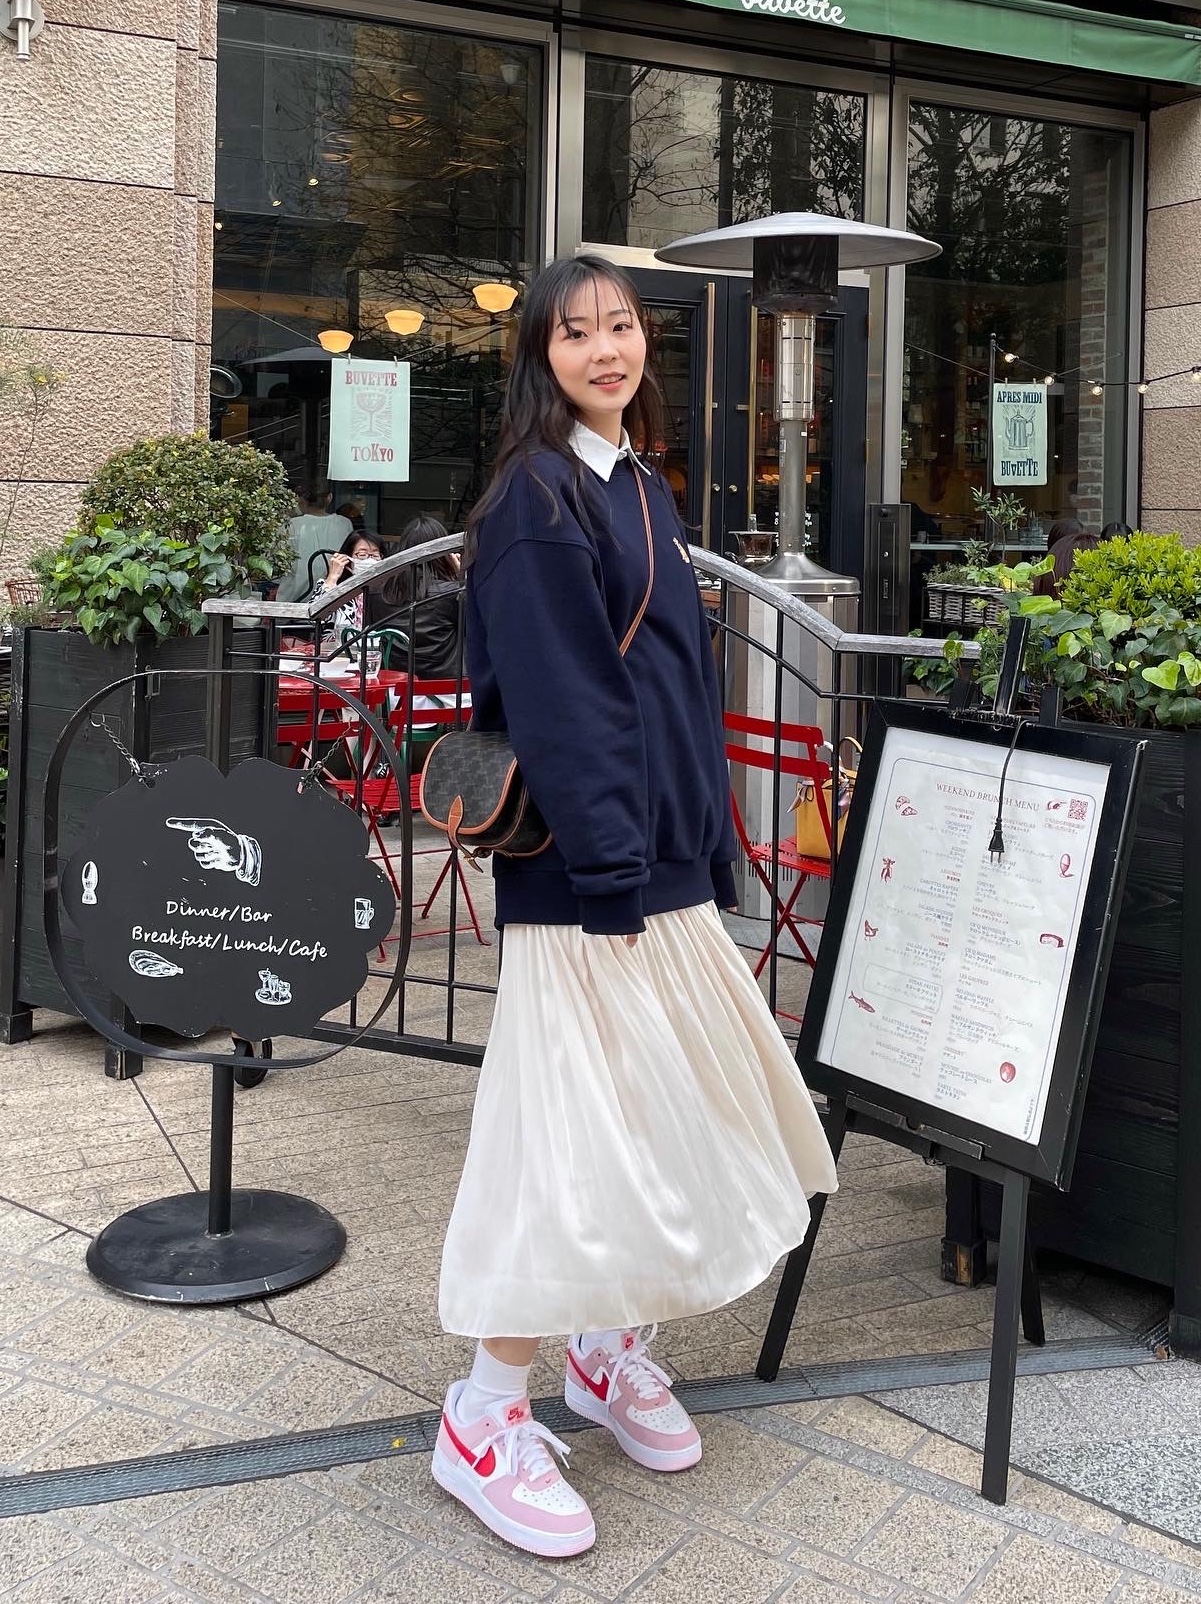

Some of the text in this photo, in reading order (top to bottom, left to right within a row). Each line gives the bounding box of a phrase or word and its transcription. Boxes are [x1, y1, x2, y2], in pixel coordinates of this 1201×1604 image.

[345, 370, 397, 387] BUVETTE
[997, 391, 1042, 404] APRES MIDI
[936, 783, 976, 798] WEEKEND
[1014, 798, 1040, 812] MENU
[166, 900, 272, 922] Dinner/Bar
[132, 925, 328, 962] Breakfast/Lunch/Cafe
